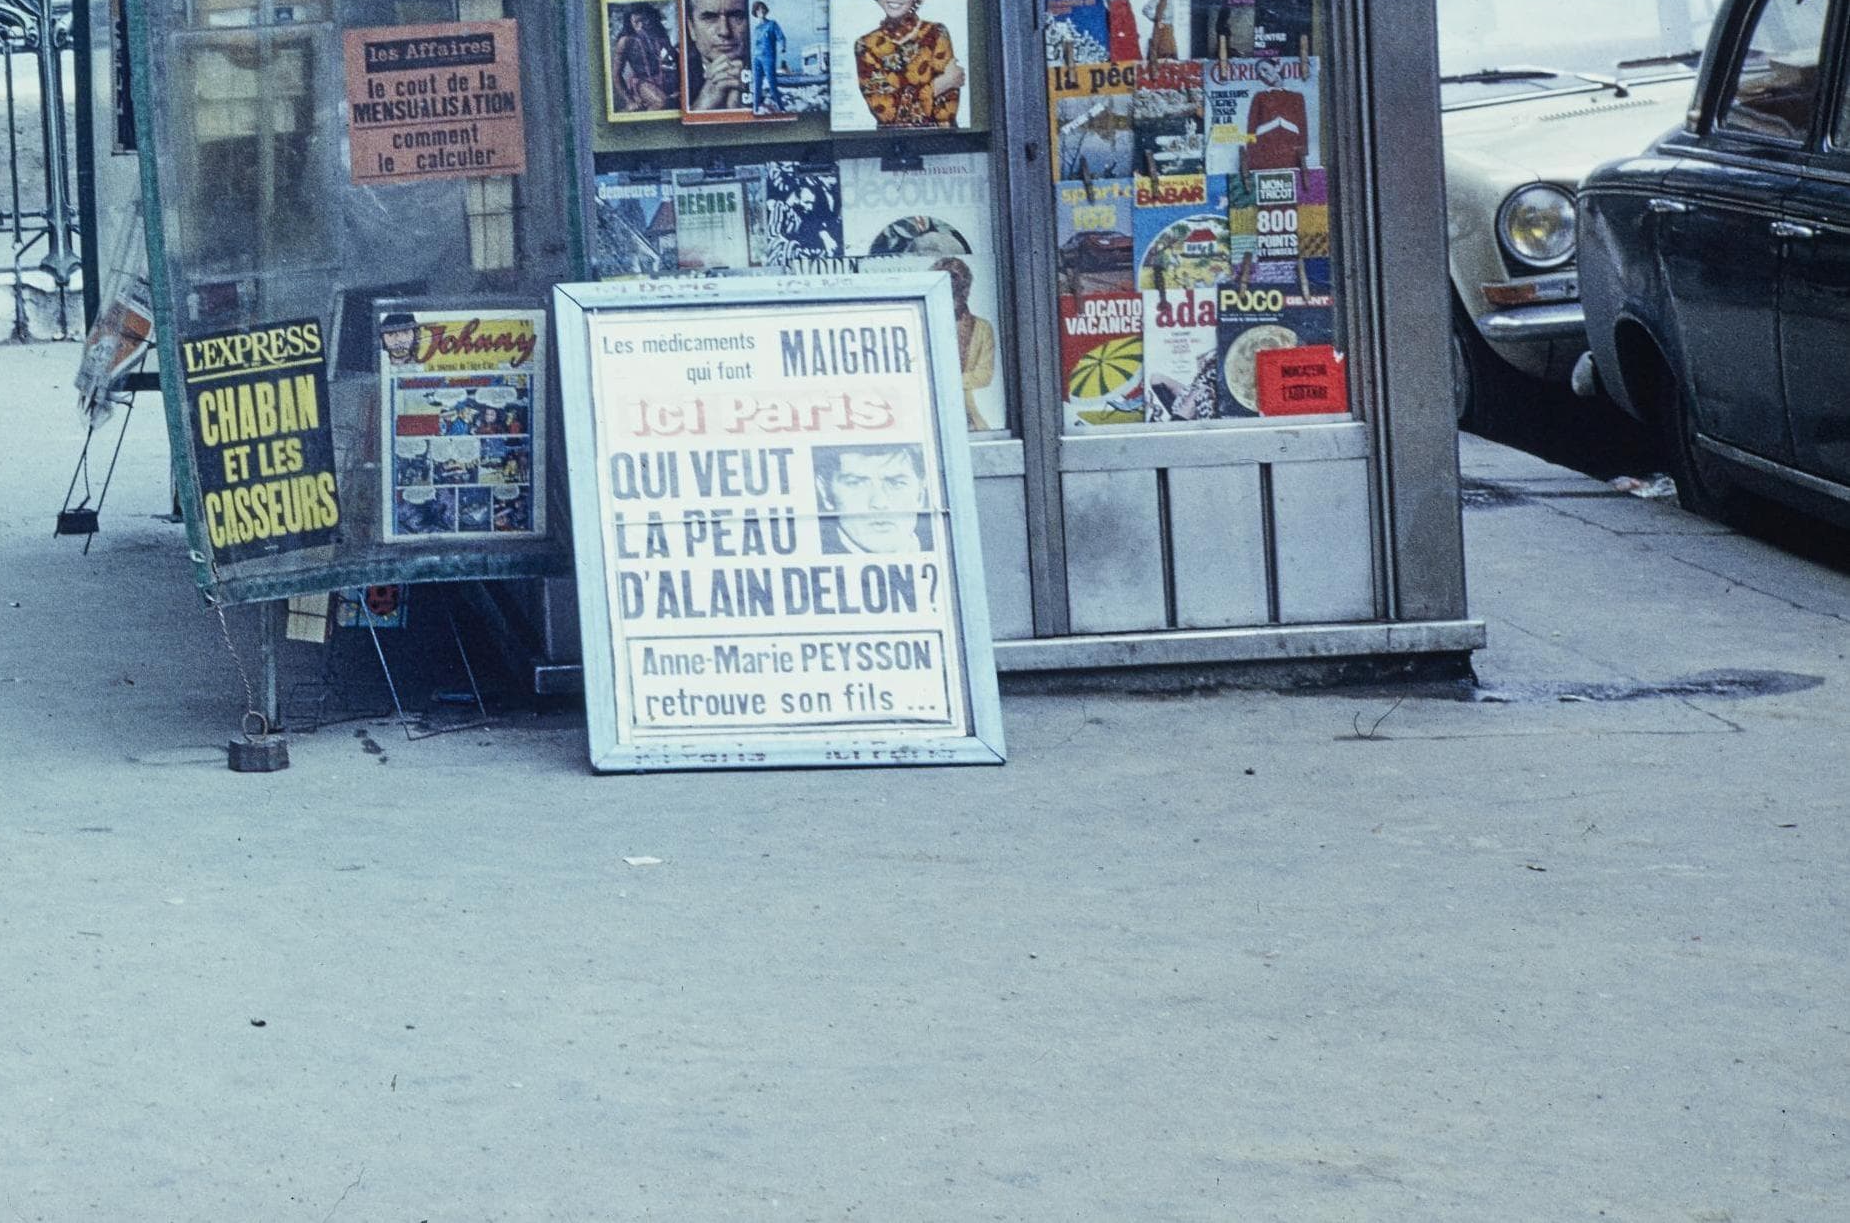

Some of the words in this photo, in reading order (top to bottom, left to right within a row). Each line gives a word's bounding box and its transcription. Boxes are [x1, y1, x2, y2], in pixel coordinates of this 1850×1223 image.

[369, 44, 400, 63] les
[407, 37, 493, 60] Affaires
[369, 78, 385, 98] le
[396, 76, 438, 97] cout
[447, 72, 469, 93] de
[479, 72, 498, 92] la
[353, 90, 515, 124] MENSUALISATION
[393, 126, 480, 149] comment
[379, 154, 395, 173] le
[417, 148, 496, 170] calculer
[1137, 186, 1205, 205] BABAR
[1257, 209, 1298, 233] 800
[1257, 234, 1298, 248] POINTS
[184, 323, 322, 372] L'EXPRESS
[415, 318, 538, 368] Johnny
[603, 336, 634, 355] Les
[780, 325, 912, 378] MAIGRIR
[687, 364, 711, 386] qui
[718, 362, 752, 381] font
[198, 375, 319, 447] CHABAN
[224, 447, 251, 484] ET
[259, 438, 304, 476] LES
[609, 451, 680, 501] QUI
[689, 447, 794, 498] VEUT
[206, 472, 340, 549] CASSEURS
[616, 510, 670, 560] LA
[683, 506, 798, 560] PEAU
[619, 567, 776, 621] D'ALAIN
[643, 644, 794, 677] Anne-Marie
[802, 639, 932, 673] PEYSSON
[646, 688, 766, 718] retrouve
[782, 691, 831, 714] son
[844, 683, 893, 711] fils
